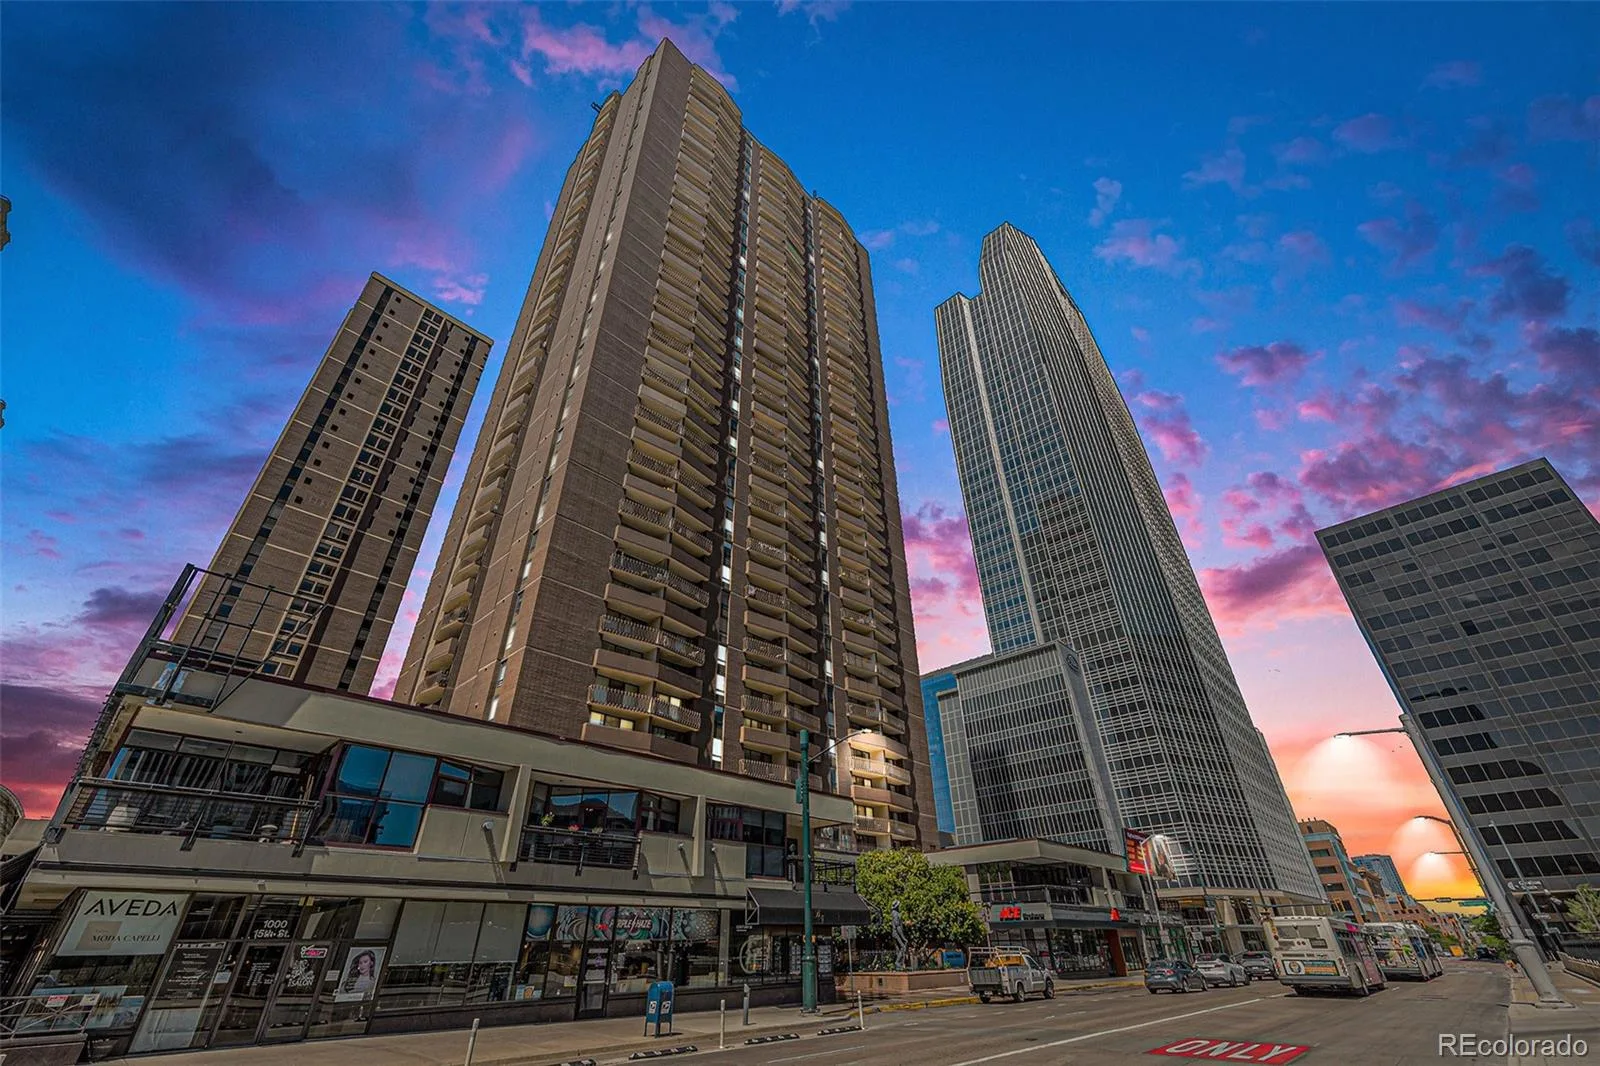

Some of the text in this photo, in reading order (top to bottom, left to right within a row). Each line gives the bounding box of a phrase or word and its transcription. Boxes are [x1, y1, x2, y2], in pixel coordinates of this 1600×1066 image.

[84, 898, 178, 917] AVEDA
[1000, 906, 1022, 919] ACE
[263, 919, 288, 929] 1000
[608, 919, 633, 929] PRPLE
[1166, 1040, 1297, 1061] ONLY
